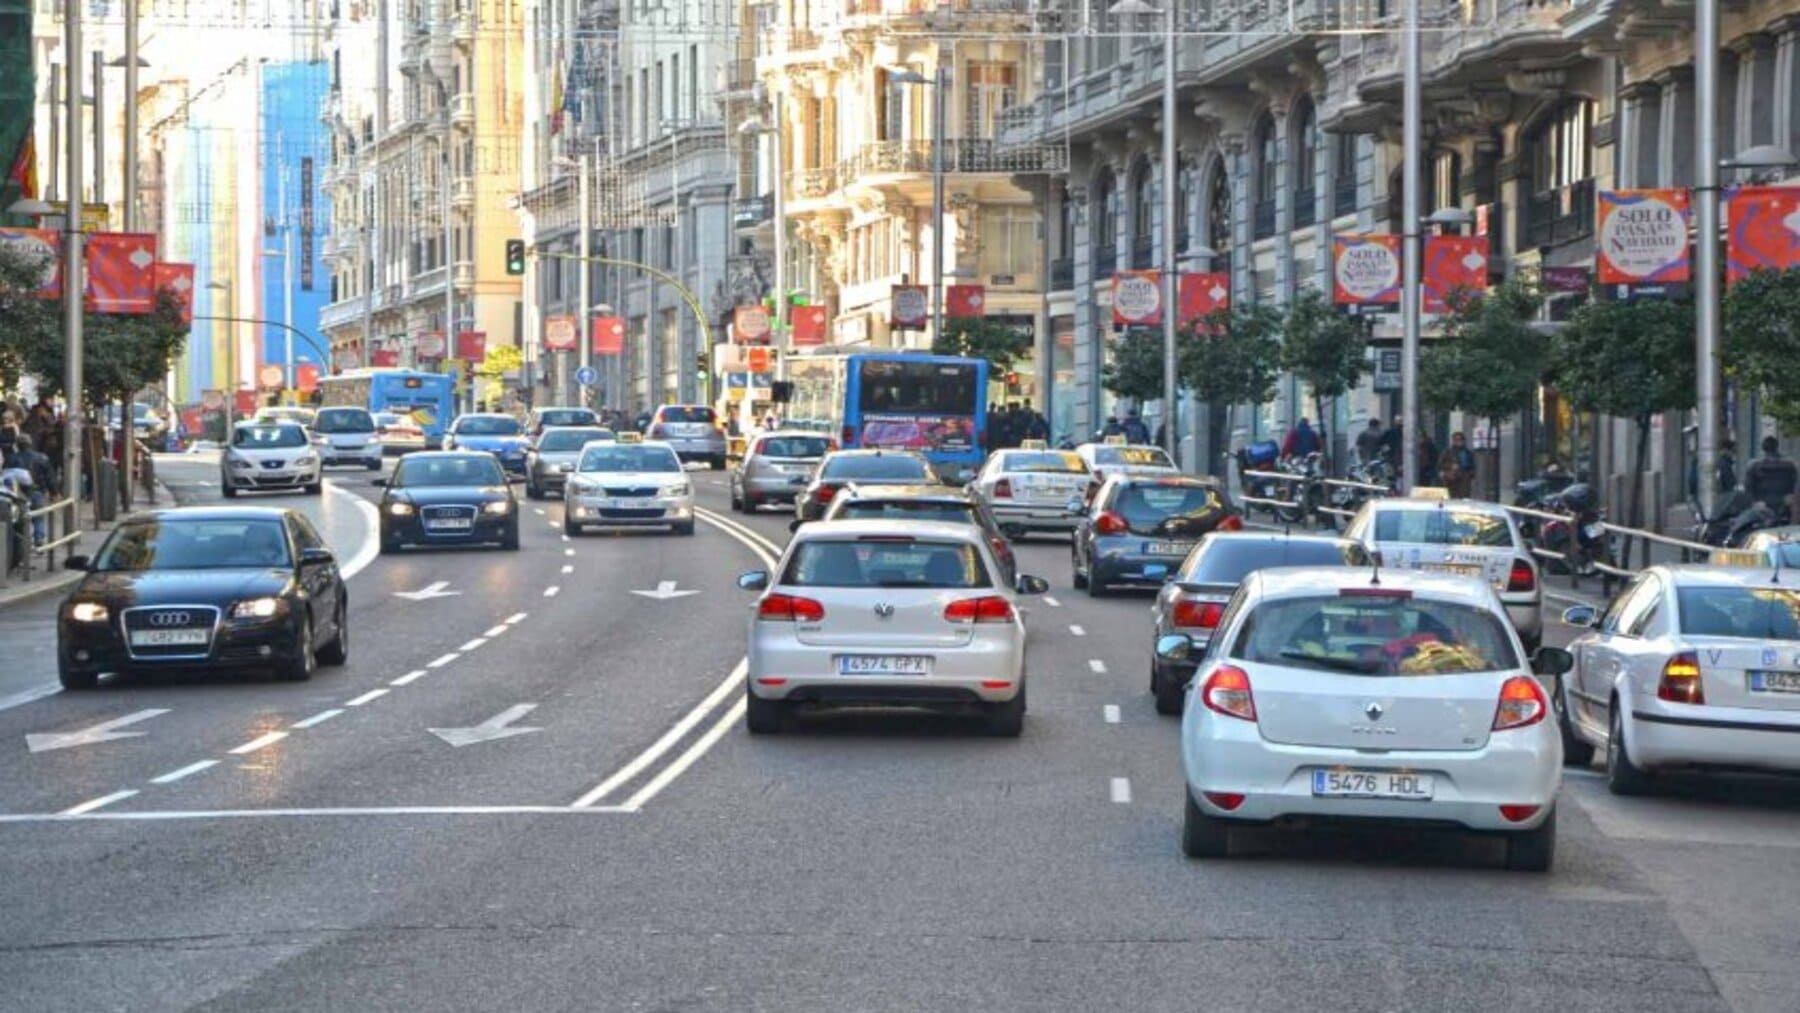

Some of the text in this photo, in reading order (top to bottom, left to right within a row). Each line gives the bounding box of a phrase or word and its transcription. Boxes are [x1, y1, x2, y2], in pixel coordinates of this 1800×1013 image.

[1618, 208, 1672, 222] SOLO
[1615, 223, 1658, 236] PASA
[1611, 236, 1676, 252] NAVIDAD
[850, 656, 924, 671] 4574 GPX
[1328, 773, 1427, 795] 5476 HDL
